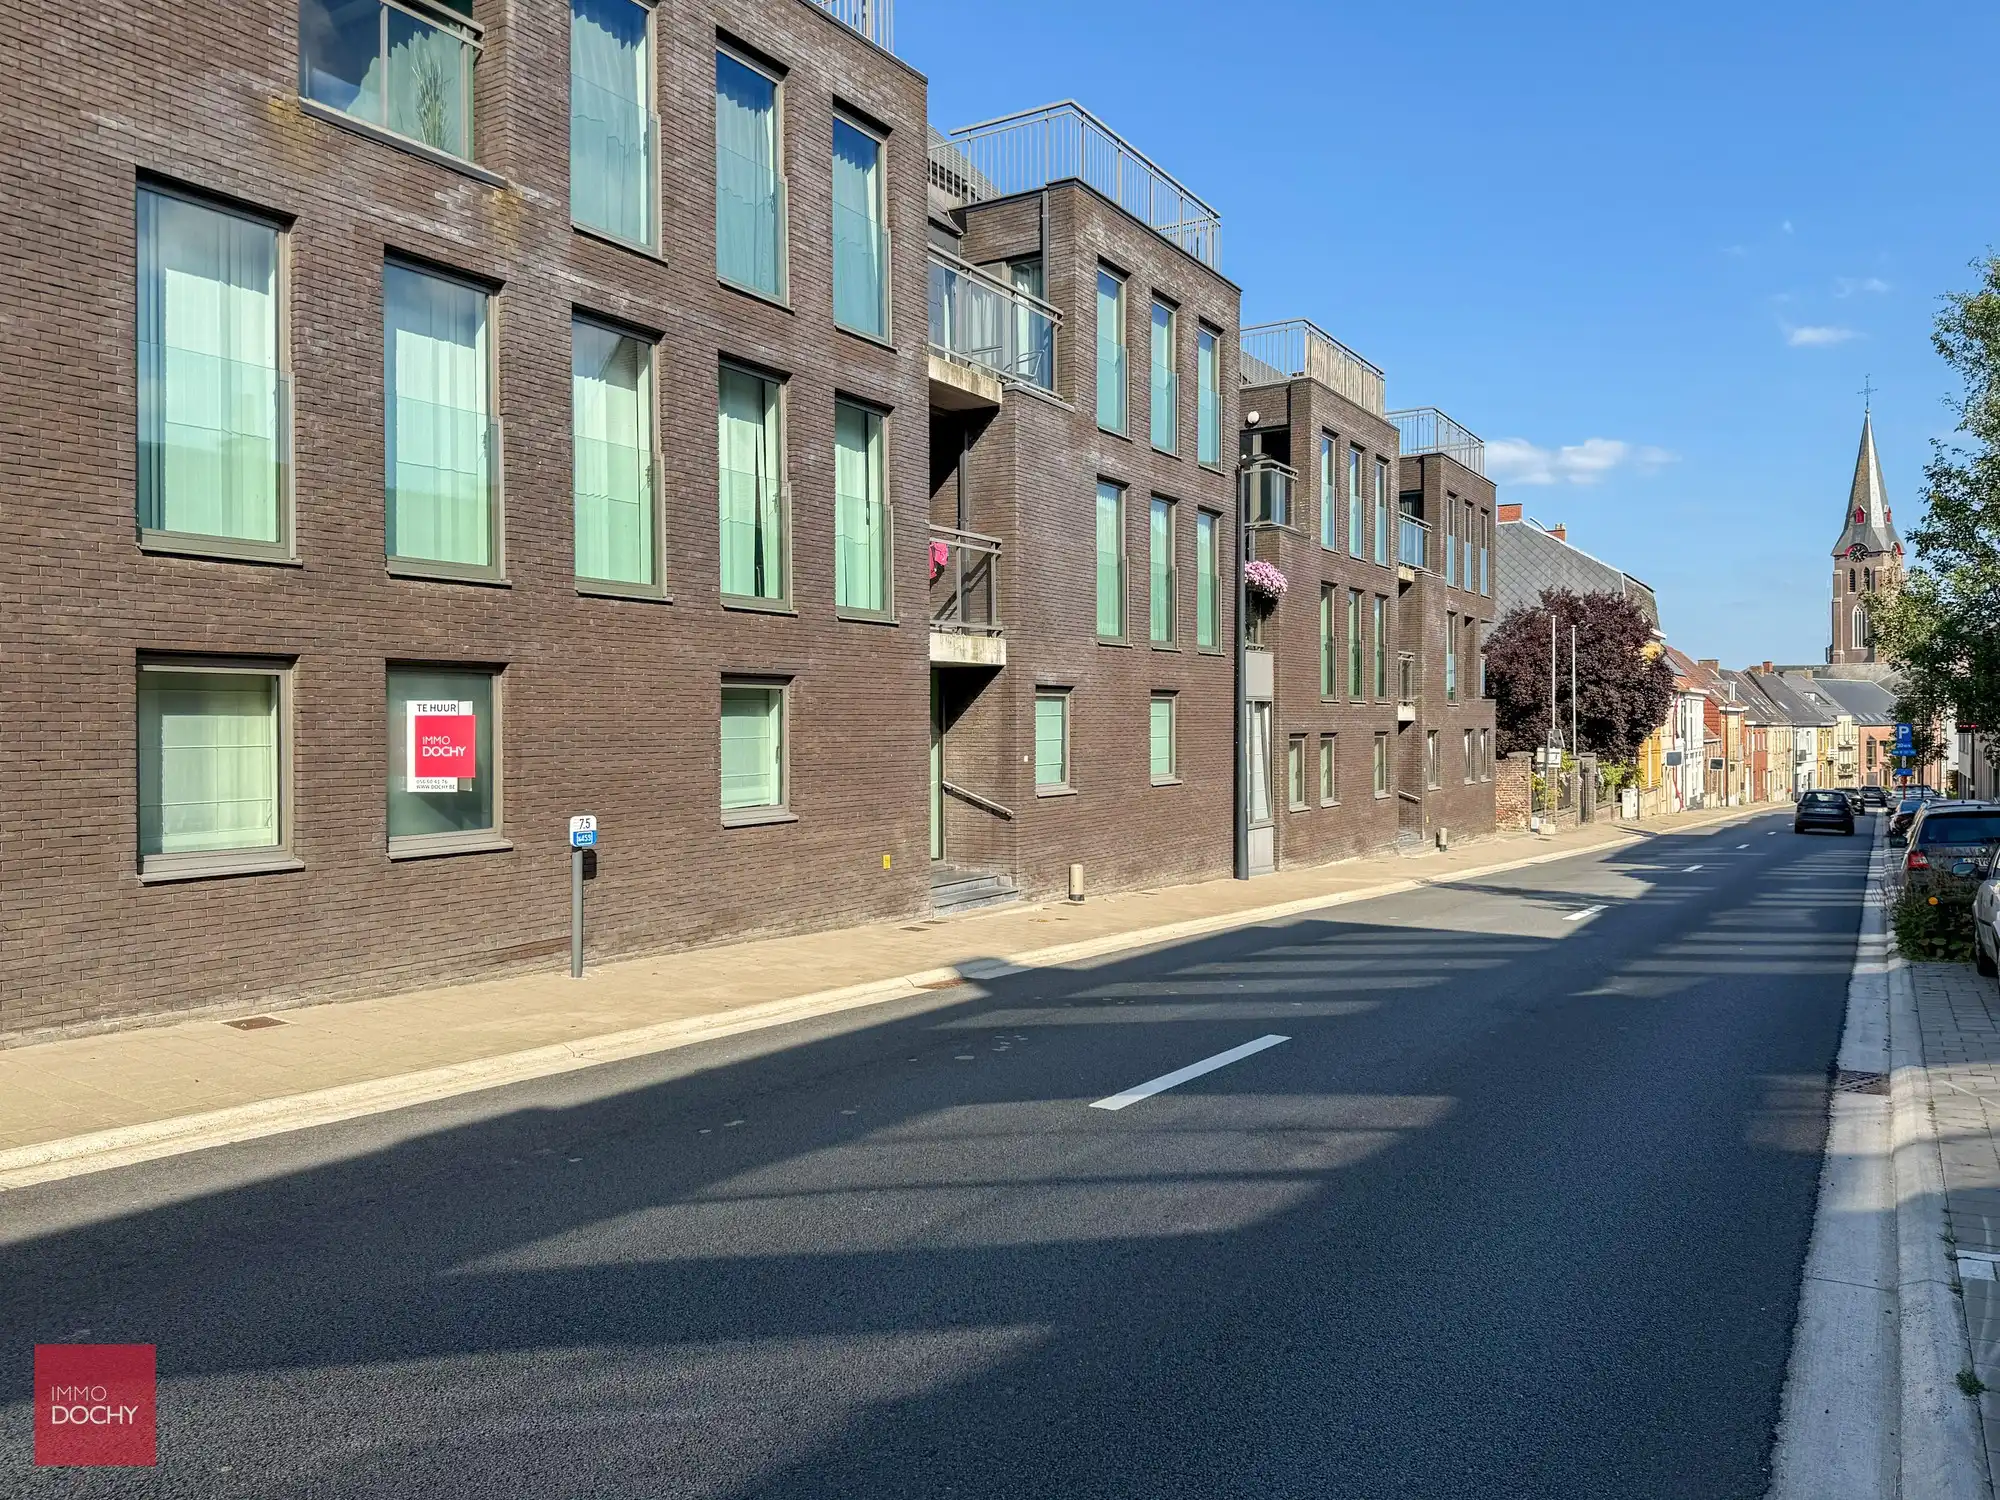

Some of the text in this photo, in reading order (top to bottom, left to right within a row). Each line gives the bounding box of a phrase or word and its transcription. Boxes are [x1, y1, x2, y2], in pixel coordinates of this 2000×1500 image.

[416, 704, 457, 712] TE HUUR
[1898, 726, 1909, 739] P
[422, 736, 450, 745] IMMO
[422, 746, 466, 757] DOCHY
